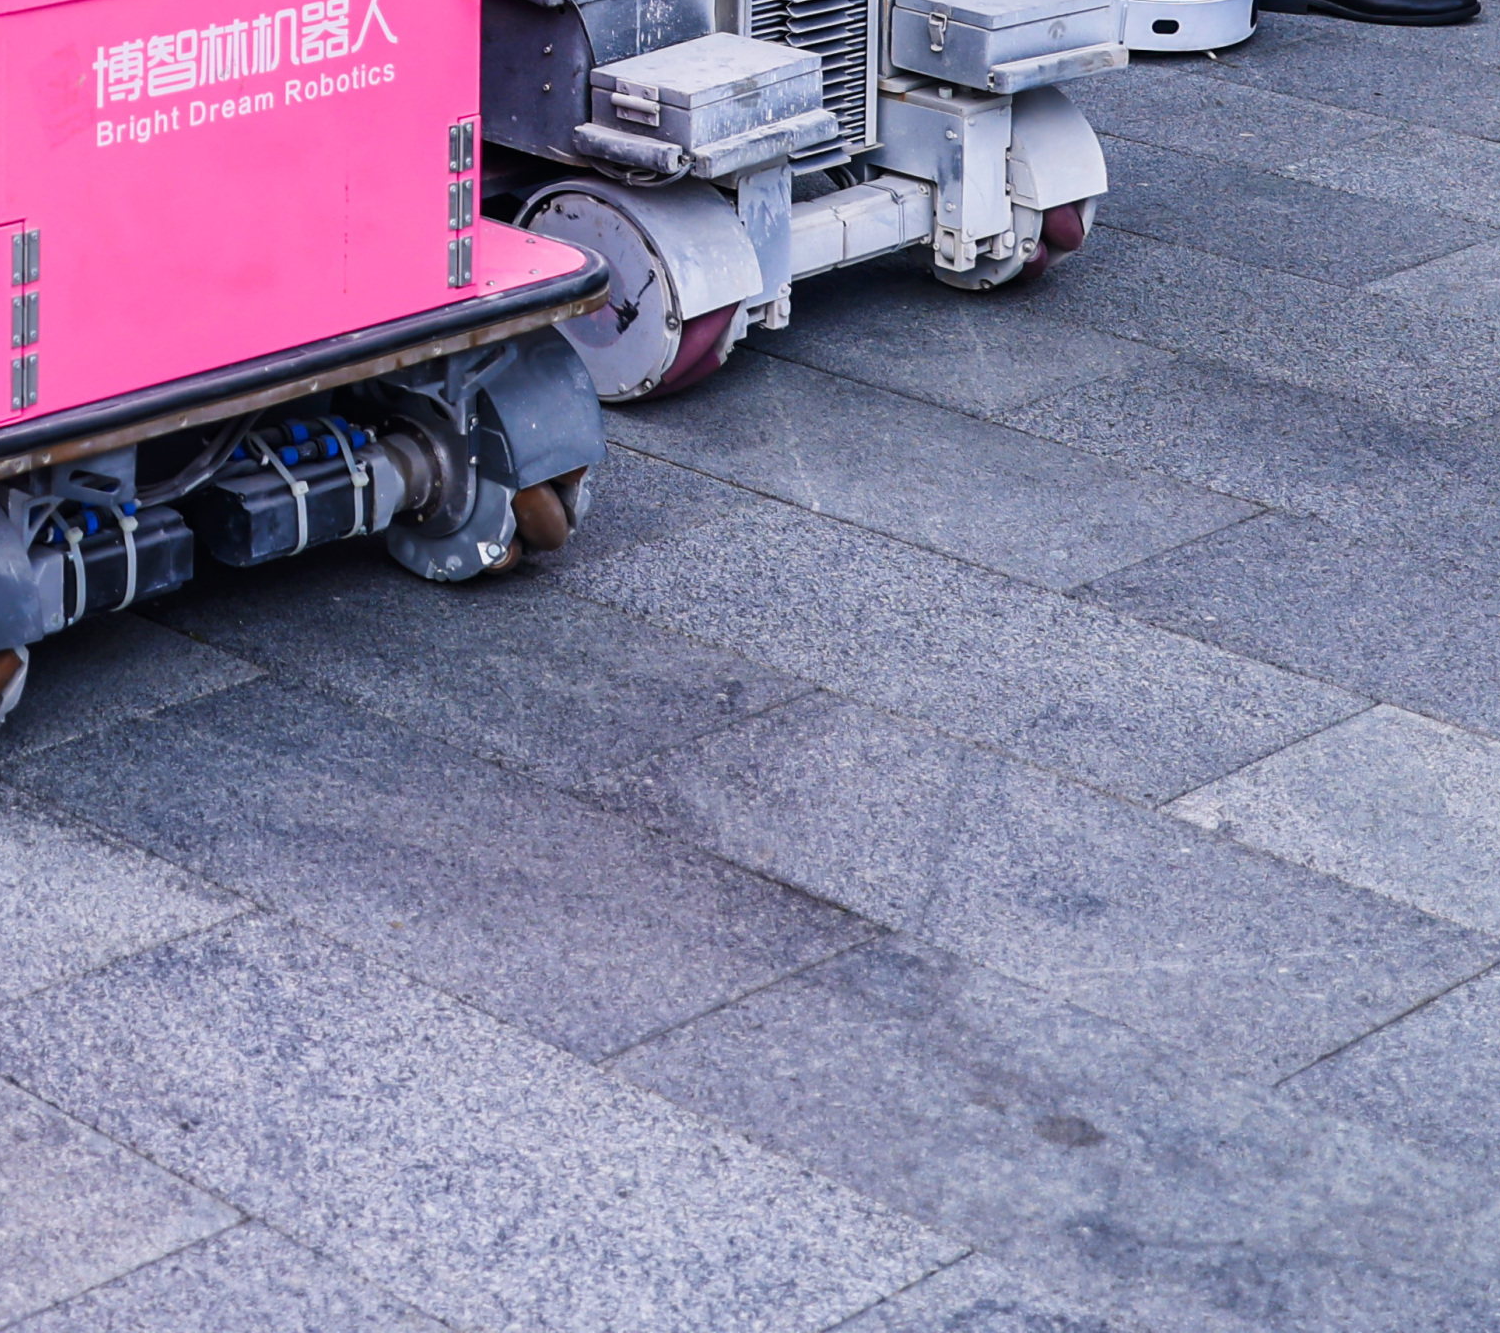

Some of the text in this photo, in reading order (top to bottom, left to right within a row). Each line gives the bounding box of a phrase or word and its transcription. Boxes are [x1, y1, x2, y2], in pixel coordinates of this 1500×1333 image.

[97, 63, 396, 147] Bright Dream Robotics
